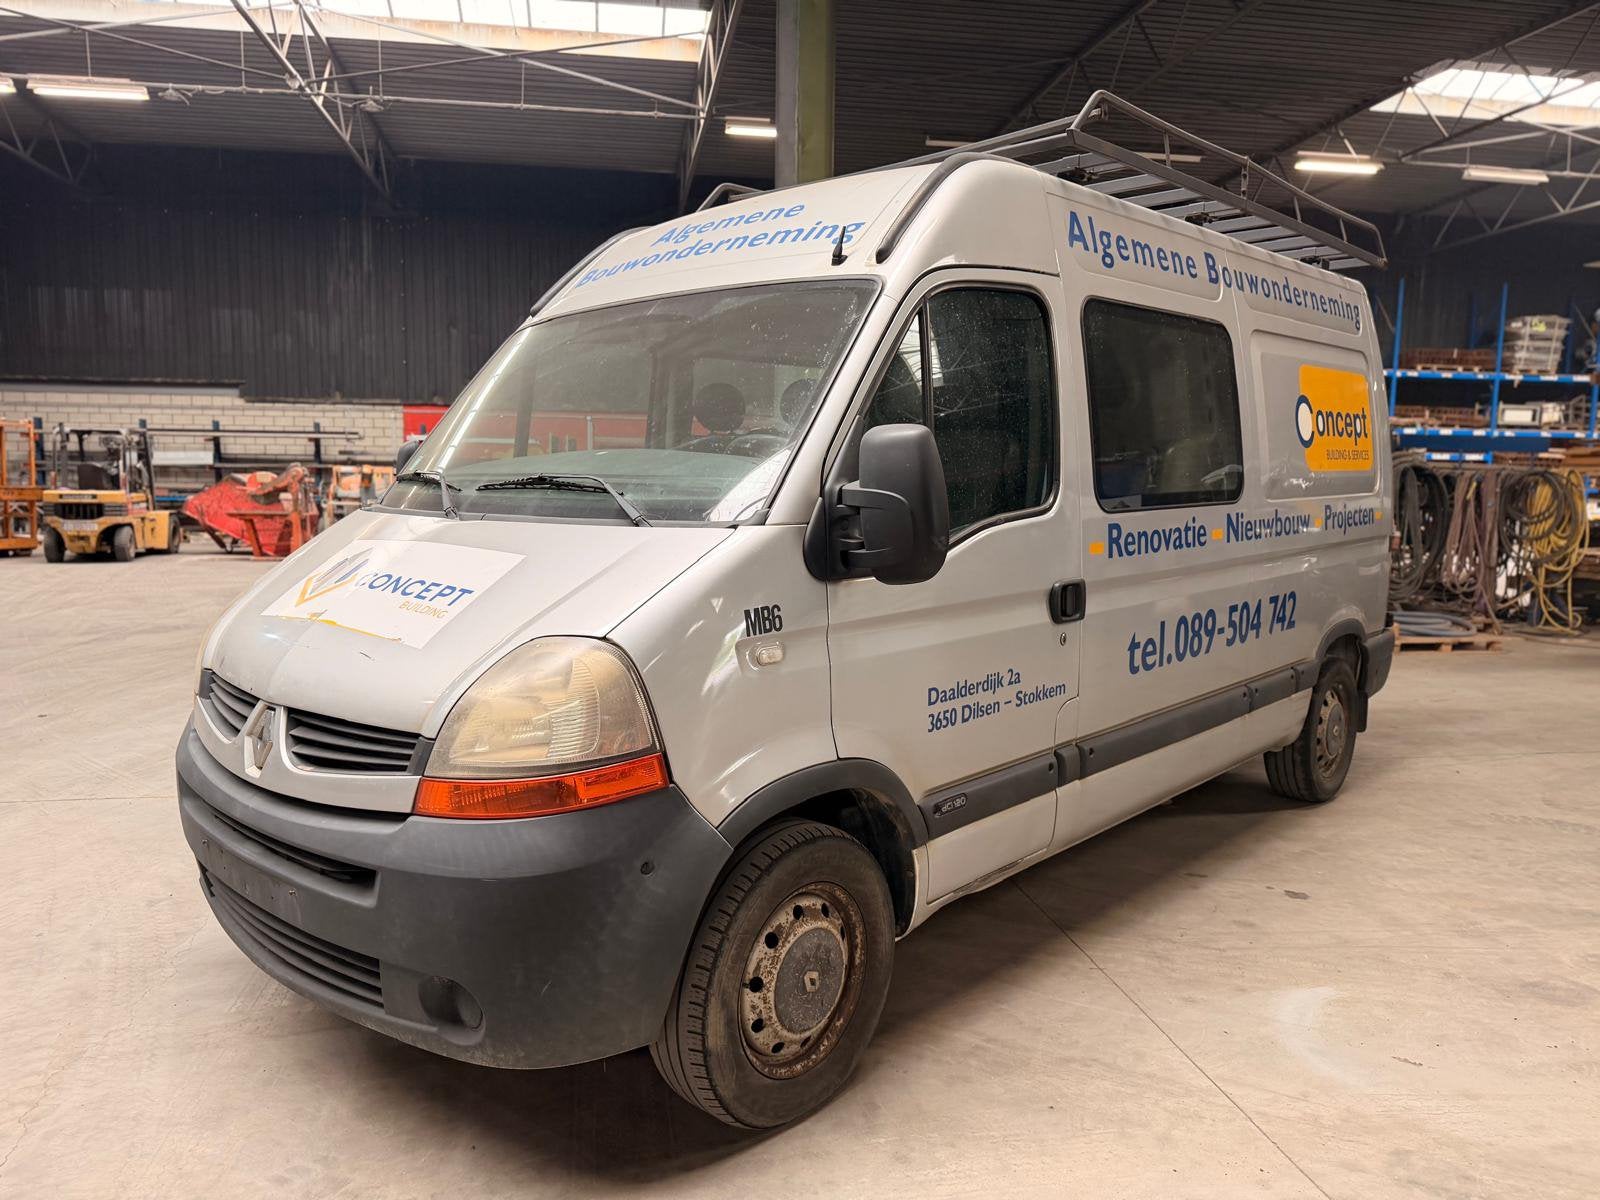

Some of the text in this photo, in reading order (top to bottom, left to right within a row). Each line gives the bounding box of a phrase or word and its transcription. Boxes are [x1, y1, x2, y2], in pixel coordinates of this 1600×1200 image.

[650, 203, 806, 248] Algemene
[574, 220, 866, 289] Bouwonderneming
[1068, 210, 1361, 332] Algemene Bouwonderneming
[1295, 394, 1369, 449] Concept
[1107, 503, 1375, 559] Renovatie Nieuwbouw Projecten
[398, 600, 449, 619] BUILDING
[743, 604, 783, 637] MB6
[1127, 591, 1297, 675] tel.089-504 742
[927, 668, 1022, 707] Daalderdijk 2a
[927, 707, 958, 733] 3650
[961, 700, 1001, 724] Dilsen
[1015, 682, 1067, 708] Stokkem
